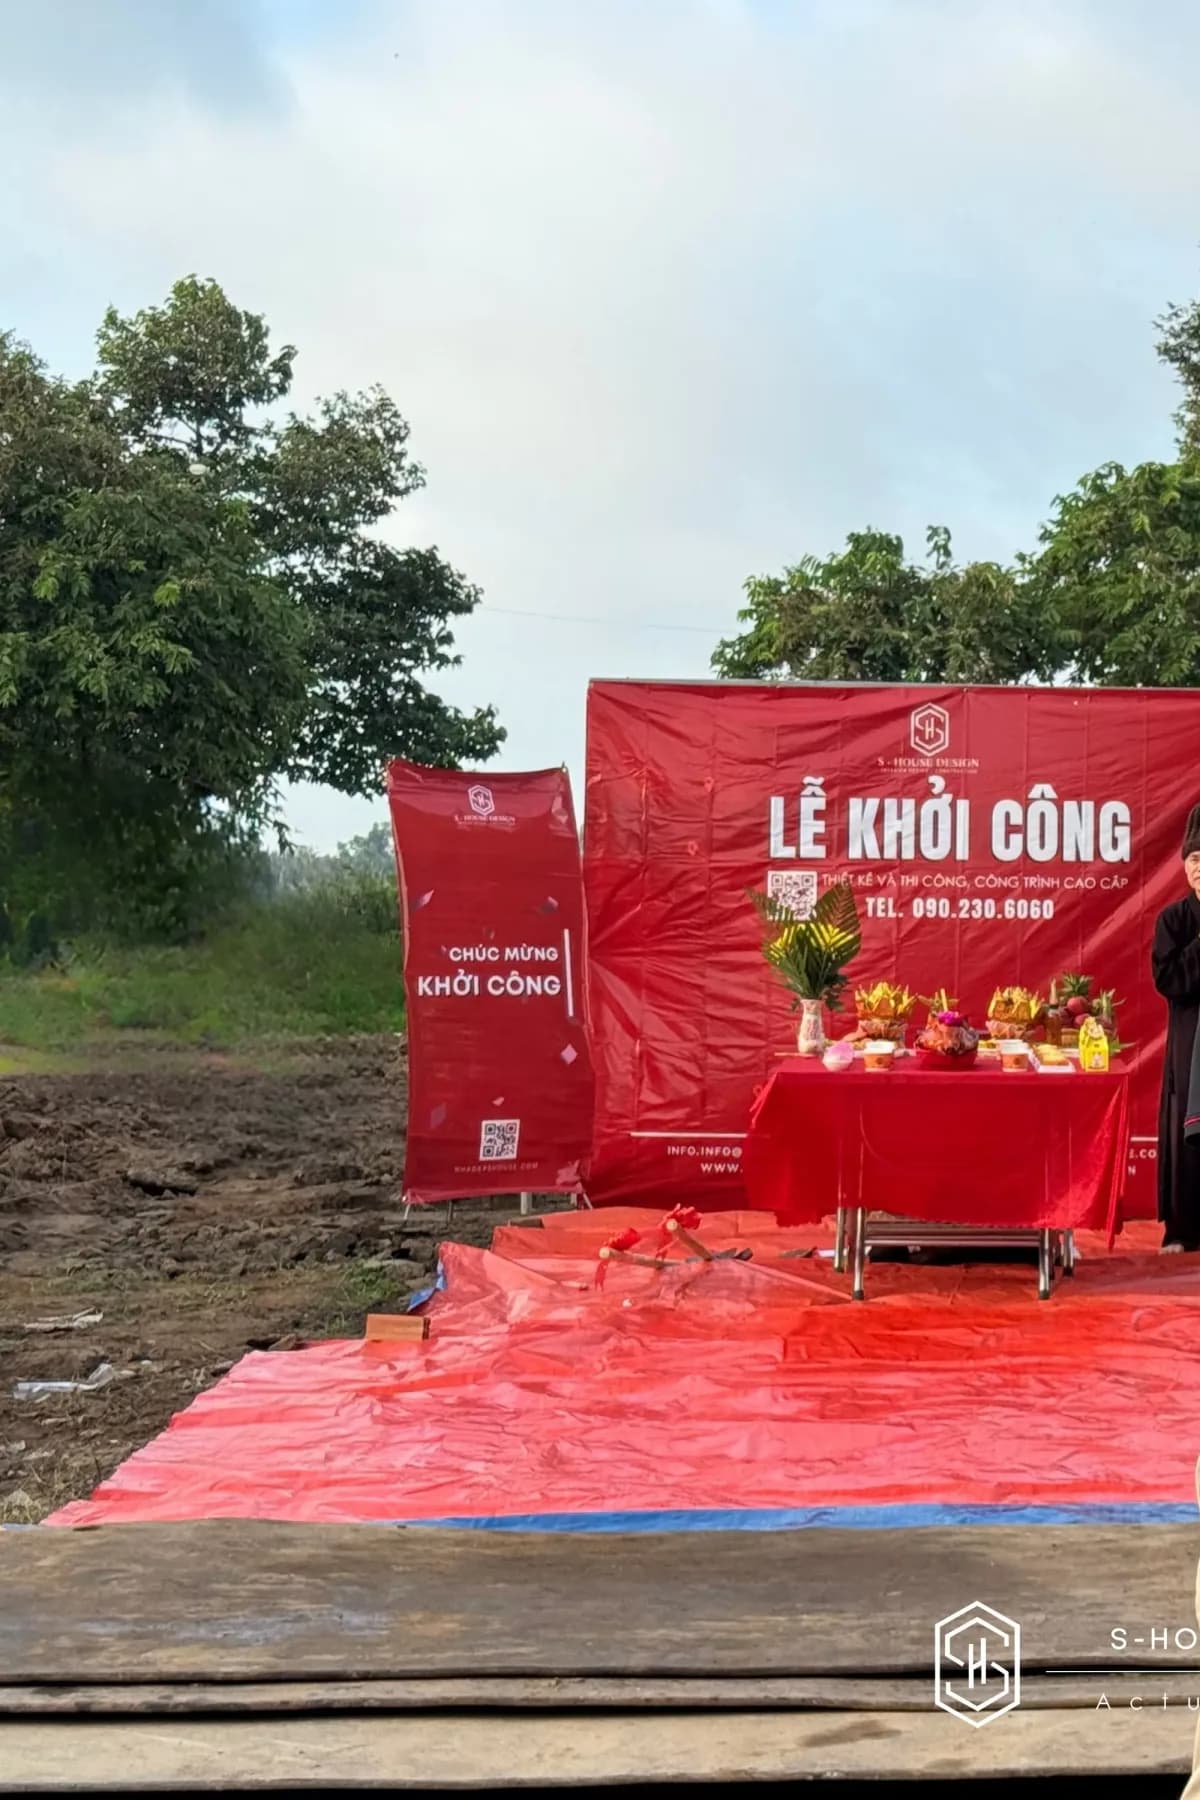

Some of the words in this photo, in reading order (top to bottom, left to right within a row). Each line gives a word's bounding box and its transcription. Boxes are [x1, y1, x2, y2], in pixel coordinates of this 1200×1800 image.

[894, 758, 933, 768] HOUSE
[935, 758, 979, 768] DESIGN
[769, 776, 827, 859] LỄ
[848, 775, 970, 862] KHỞI
[991, 783, 1131, 863] CÔNG
[857, 871, 873, 887] KẾ
[877, 872, 897, 888] VÀ
[900, 873, 918, 887] THI
[921, 873, 971, 890] CÔNG,
[974, 874, 1020, 889] CÔNG
[1023, 873, 1061, 889] TRÌNH
[1063, 876, 1097, 890] CAO
[1099, 874, 1129, 890] CẤP
[865, 897, 904, 918] TEL.
[912, 897, 1055, 920] 090.230.6060
[449, 944, 500, 962] CHÚC
[504, 943, 559, 962] MỪNG
[417, 968, 480, 997] KHỞI
[486, 970, 562, 997] CÔNG
[667, 1145, 743, 1158] INFO.INFO@
